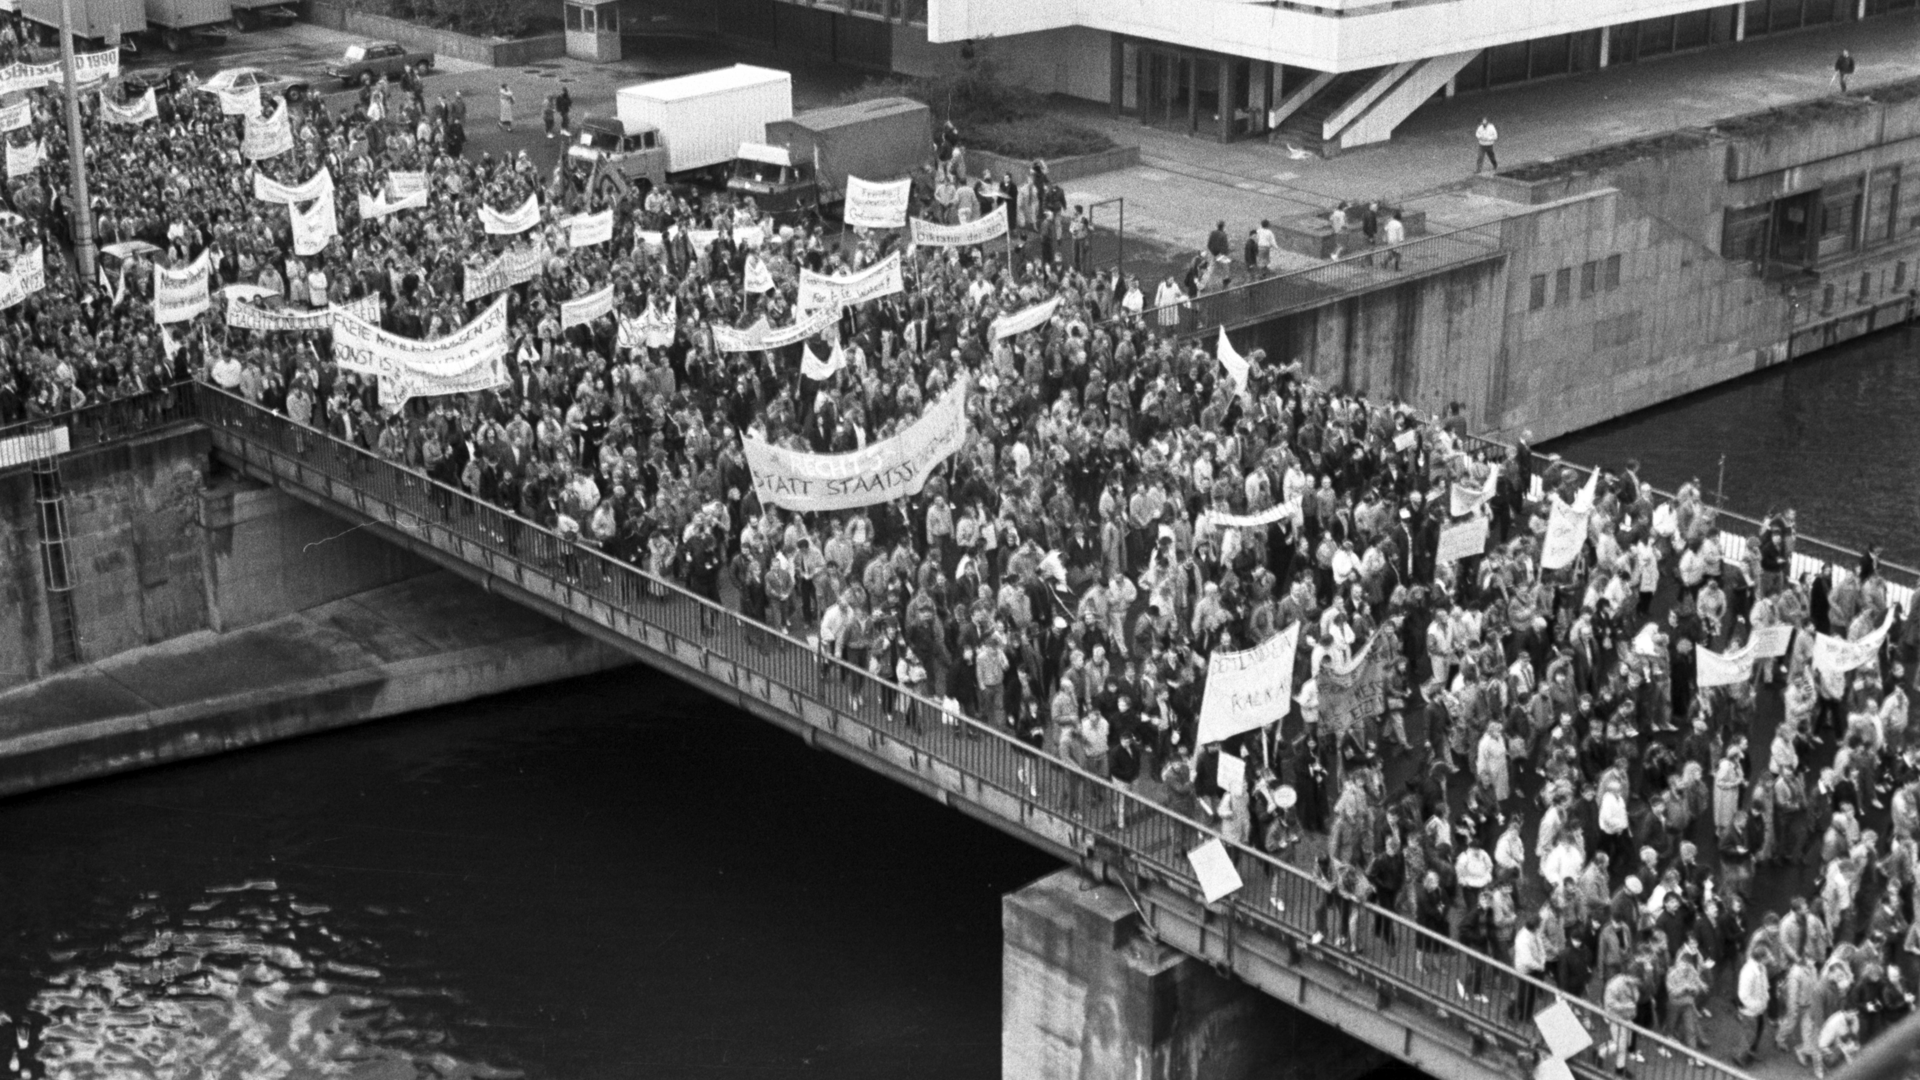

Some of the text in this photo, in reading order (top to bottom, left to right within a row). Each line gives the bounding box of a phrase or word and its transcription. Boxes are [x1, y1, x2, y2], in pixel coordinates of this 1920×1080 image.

[87, 50, 116, 69] 1990
[917, 231, 960, 243] Diktatur
[333, 312, 371, 342] FREIE
[335, 342, 375, 366] SONST
[752, 470, 814, 495] STATT
